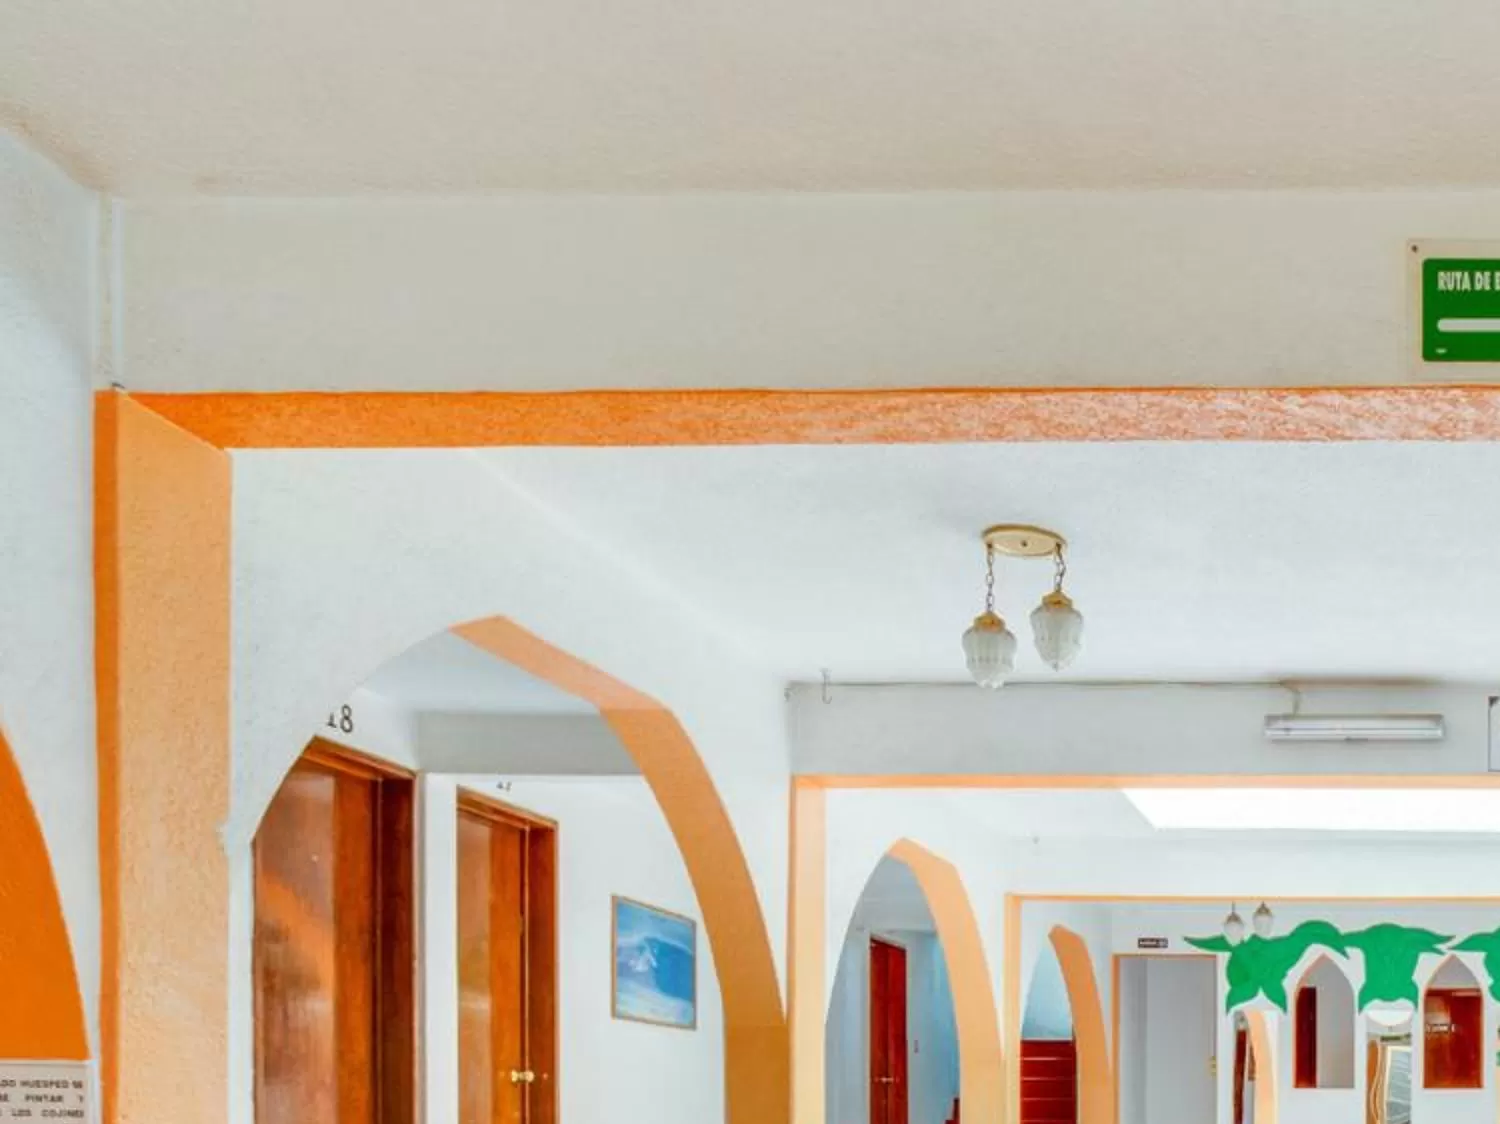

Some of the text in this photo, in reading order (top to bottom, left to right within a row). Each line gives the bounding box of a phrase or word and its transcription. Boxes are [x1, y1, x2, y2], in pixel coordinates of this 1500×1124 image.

[1437, 271, 1471, 291] RUTA
[1474, 271, 1491, 291] DE
[25, 1094, 63, 1103] PINTAR
